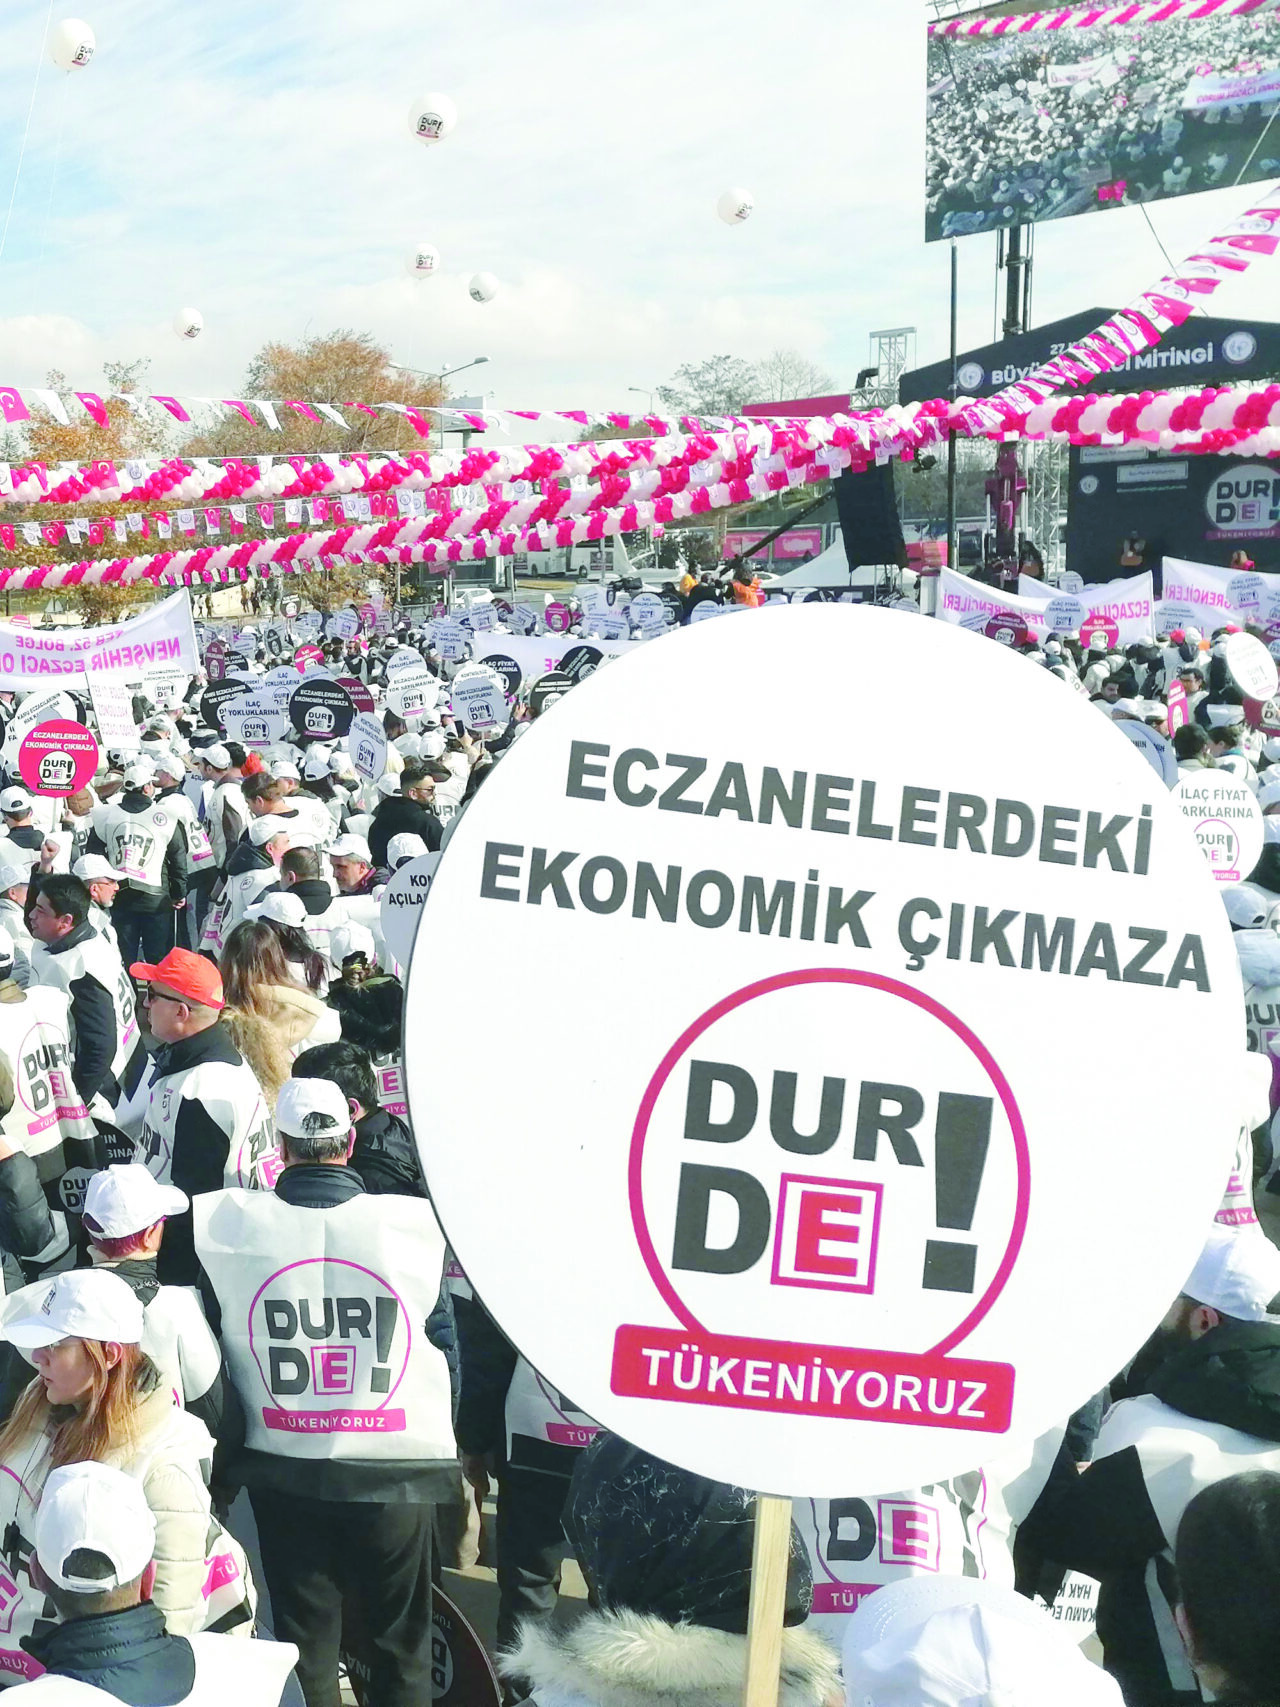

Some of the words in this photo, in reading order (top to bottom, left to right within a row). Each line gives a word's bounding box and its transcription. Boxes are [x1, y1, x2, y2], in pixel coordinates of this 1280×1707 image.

[1134, 342, 1213, 370] MİTİNGİ
[393, 674, 428, 685] ECZACILARIN
[401, 680, 435, 691] SAYILMASINA
[245, 700, 261, 709] İLAÇ
[308, 711, 327, 720] DUR
[33, 731, 89, 741] ECZANELERDEKİ
[25, 741, 63, 750] EKONOMİK
[63, 742, 95, 752] ÇIKMAZA
[359, 744, 371, 756] DUR
[43, 759, 67, 768] DUR
[1180, 788, 1210, 801] İLAÇ
[1213, 787, 1248, 801] FİYAT
[565, 739, 1154, 877] ECZANELERDEKİ
[1179, 805, 1254, 818] ARKLARINA
[479, 840, 876, 950] EKONOMİK
[897, 896, 1212, 993] ÇIKMAZA
[681, 1059, 928, 1168] DUR
[63, 1179, 90, 1191] DU
[264, 1298, 372, 1341] DUR
[641, 1347, 989, 1419] TÜKENİYORUZ
[279, 1415, 386, 1430] TÜKENİYORUZ
[1070, 1584, 1092, 1598] HAK
[1065, 1606, 1096, 1623] KAMU
